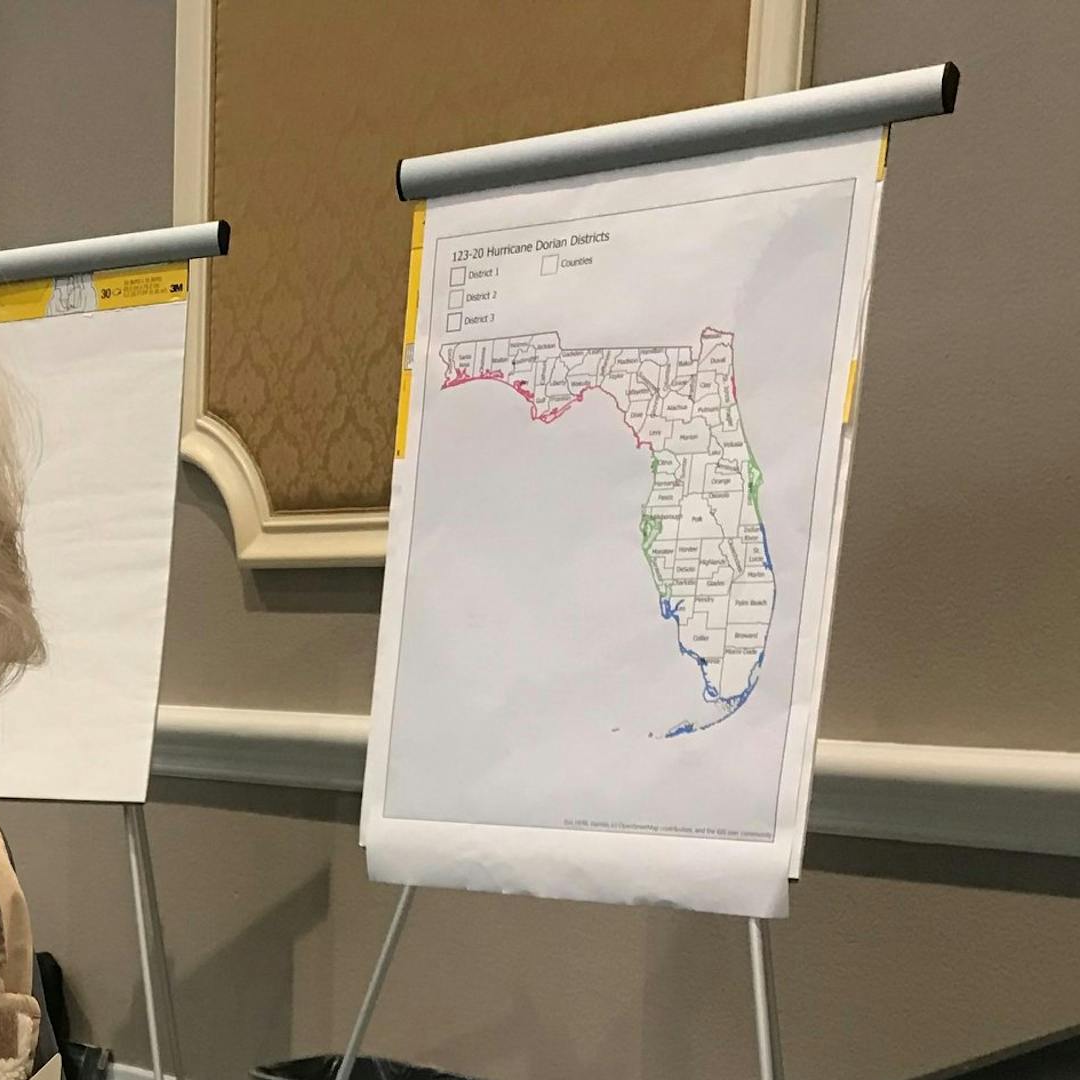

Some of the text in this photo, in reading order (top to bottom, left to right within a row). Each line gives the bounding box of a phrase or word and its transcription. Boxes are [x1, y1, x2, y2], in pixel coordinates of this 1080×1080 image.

[452, 231, 610, 262] 123-20 Hurricane Dorian Districts
[560, 256, 593, 268] Counties
[468, 268, 493, 279] District
[100, 287, 111, 300] 30
[169, 283, 183, 293] 3M
[466, 290, 497, 302] District 2
[464, 313, 495, 325] District 3
